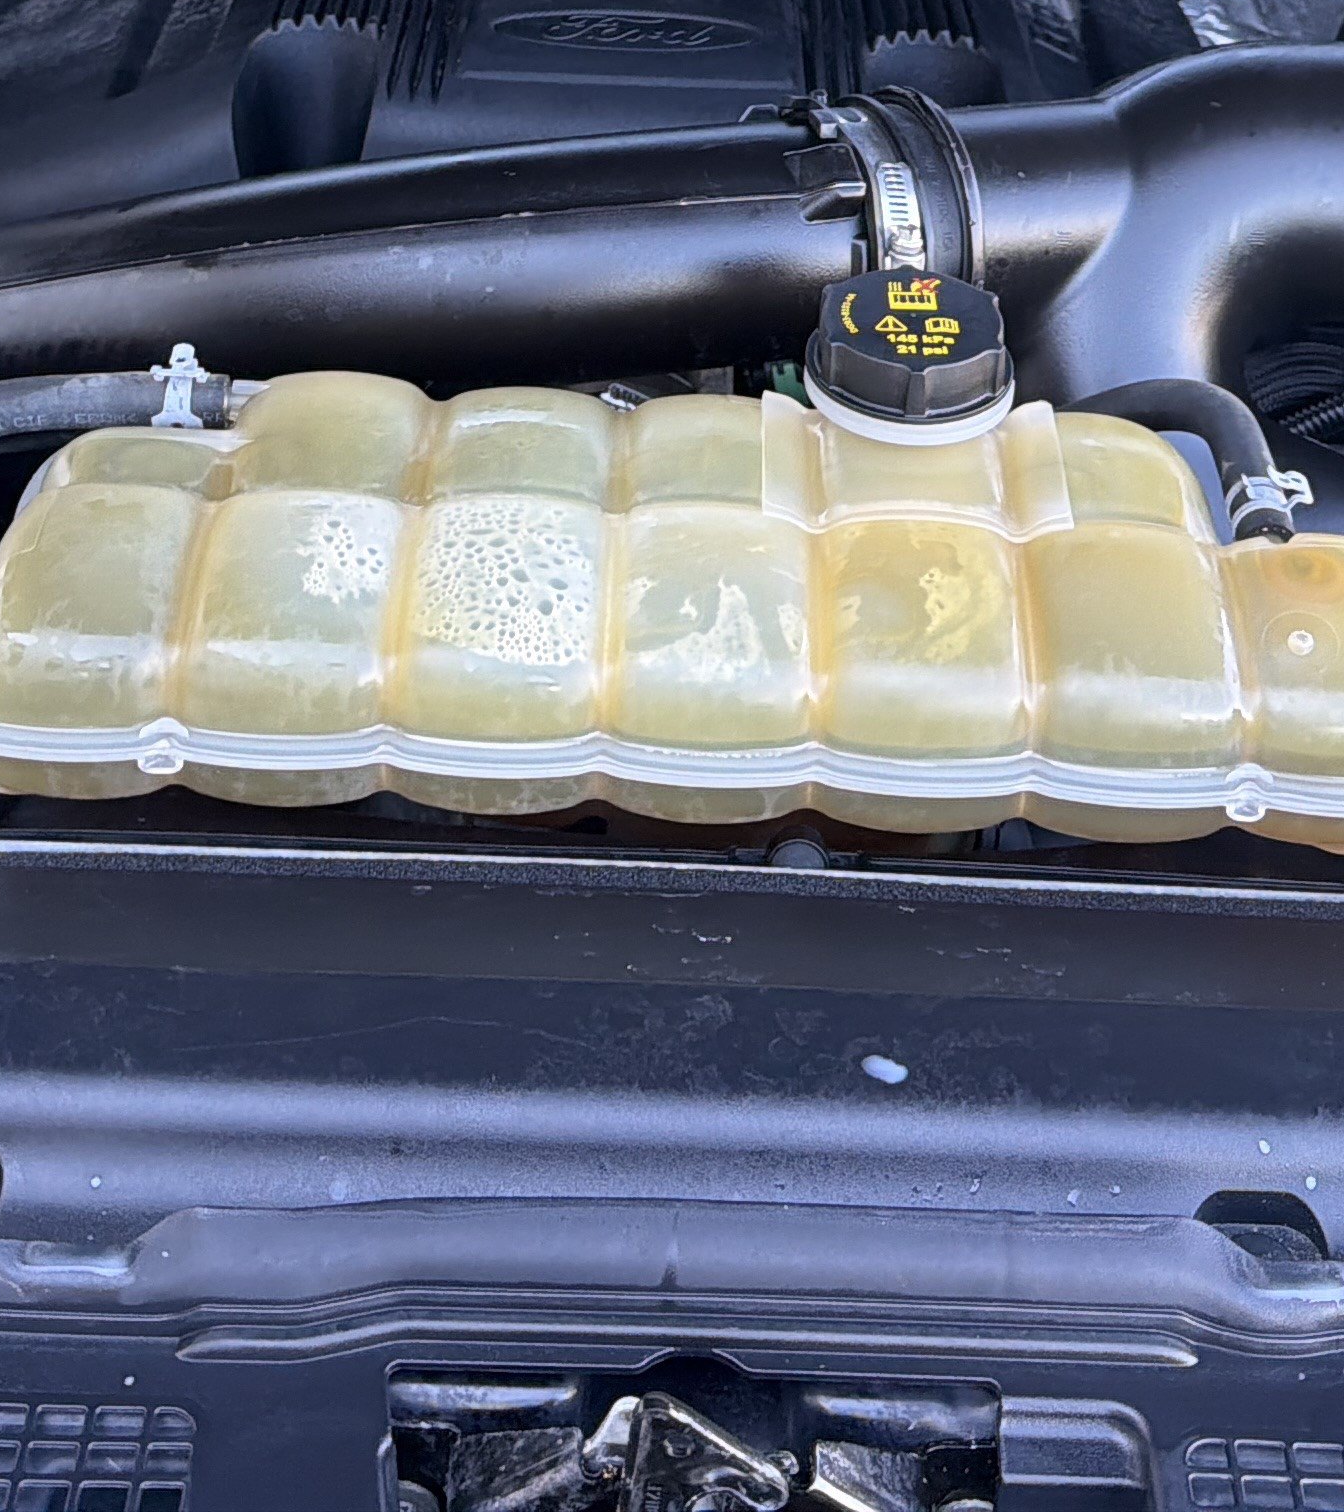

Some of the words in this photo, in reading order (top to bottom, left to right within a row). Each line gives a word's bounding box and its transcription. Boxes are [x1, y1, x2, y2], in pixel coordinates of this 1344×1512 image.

[543, 14, 715, 47] Ford
[886, 333, 919, 344] 145
[921, 334, 955, 344] kPa
[895, 344, 918, 354] 21
[922, 345, 949, 356] psi
